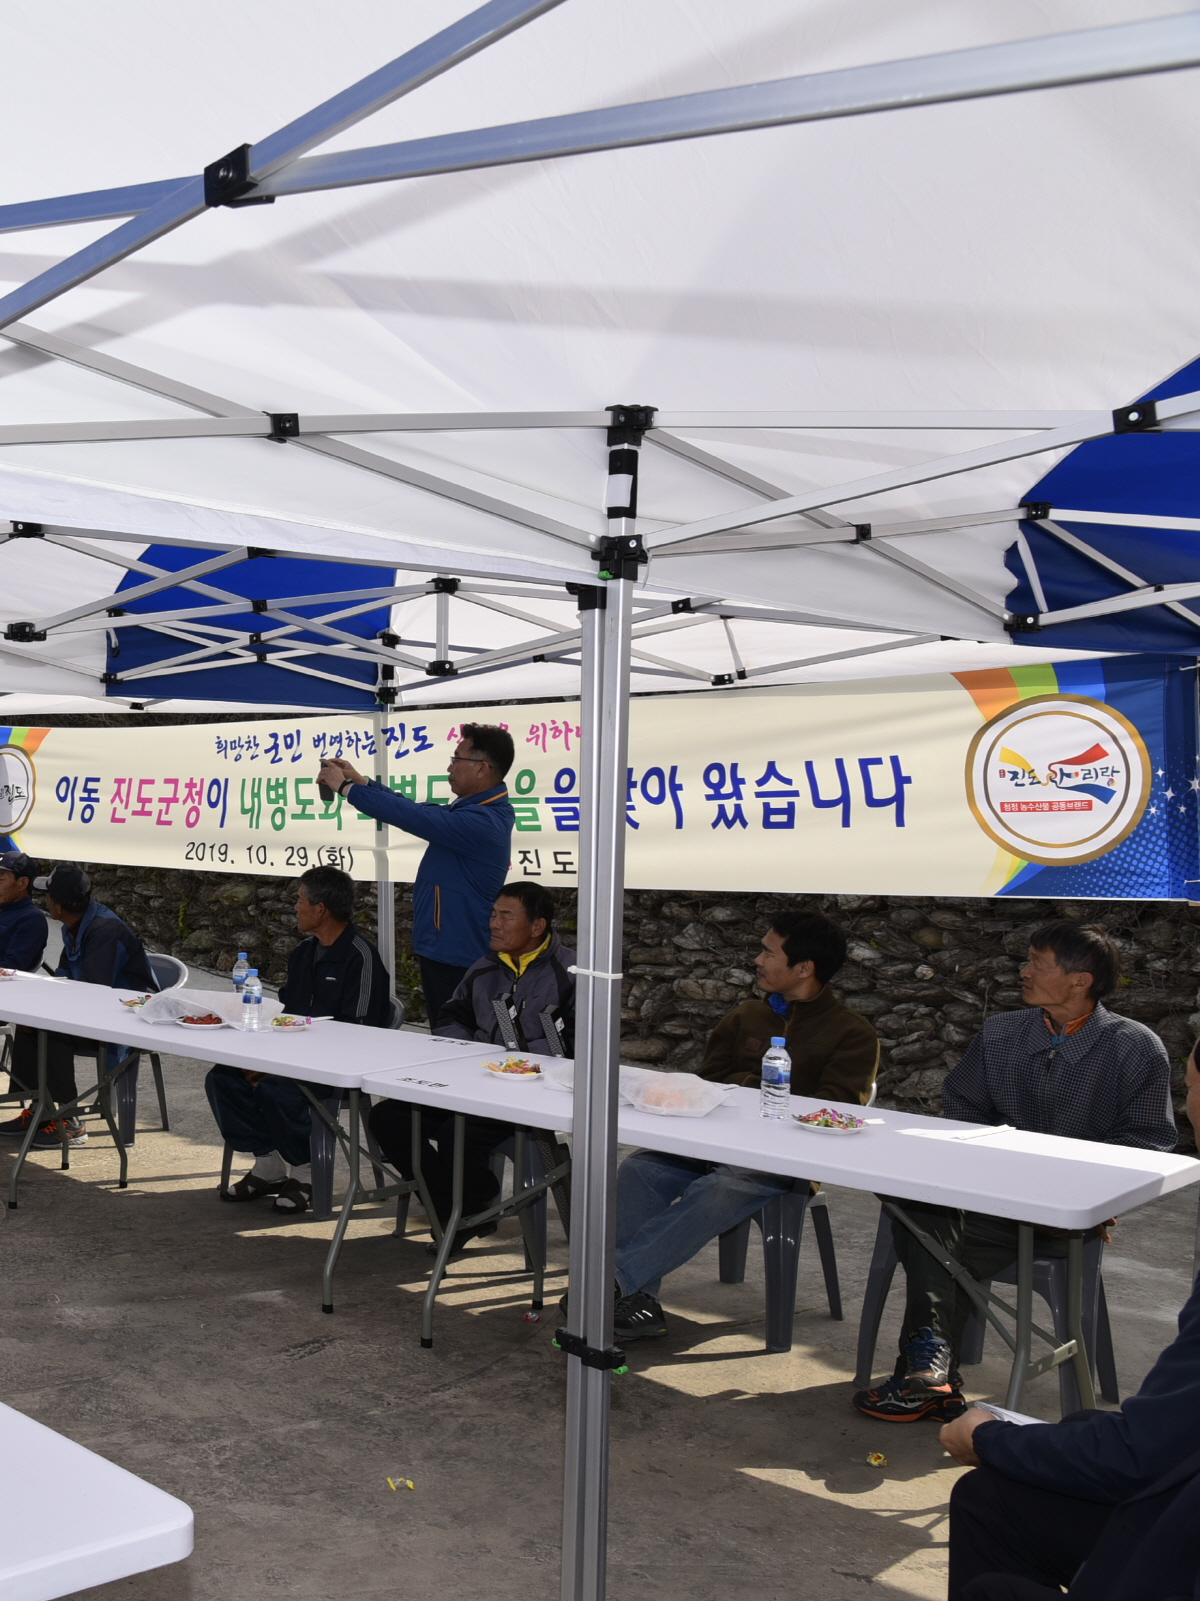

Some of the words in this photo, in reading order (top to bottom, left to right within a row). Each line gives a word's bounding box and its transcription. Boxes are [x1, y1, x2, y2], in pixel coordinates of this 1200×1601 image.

[215, 734, 261, 763] 희망찬
[264, 728, 303, 765] 군민
[312, 730, 378, 759] 번영하는
[381, 722, 435, 760] 진도
[55, 775, 102, 824] 이동
[109, 776, 229, 829] 진도군청이
[702, 754, 913, 831] 왔습니다
[184, 841, 235, 864] 2019.
[246, 844, 275, 866] 10.
